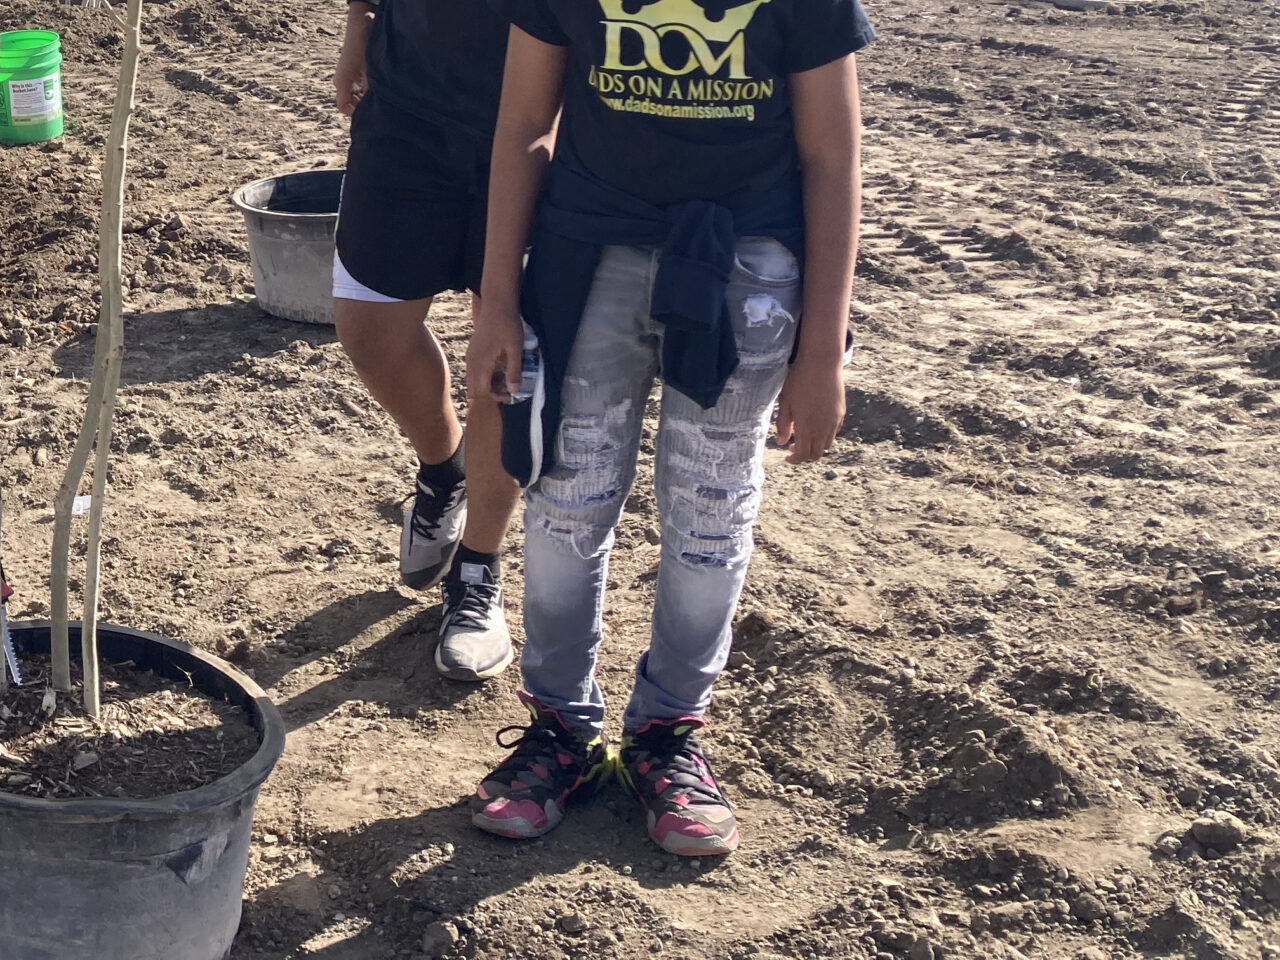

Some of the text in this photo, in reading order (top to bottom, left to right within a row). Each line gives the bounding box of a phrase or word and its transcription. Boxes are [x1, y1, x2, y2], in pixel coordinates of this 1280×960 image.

[599, 20, 753, 80] DOM
[628, 75, 663, 98] ON
[666, 79, 684, 100] A
[686, 78, 774, 101] MISSION
